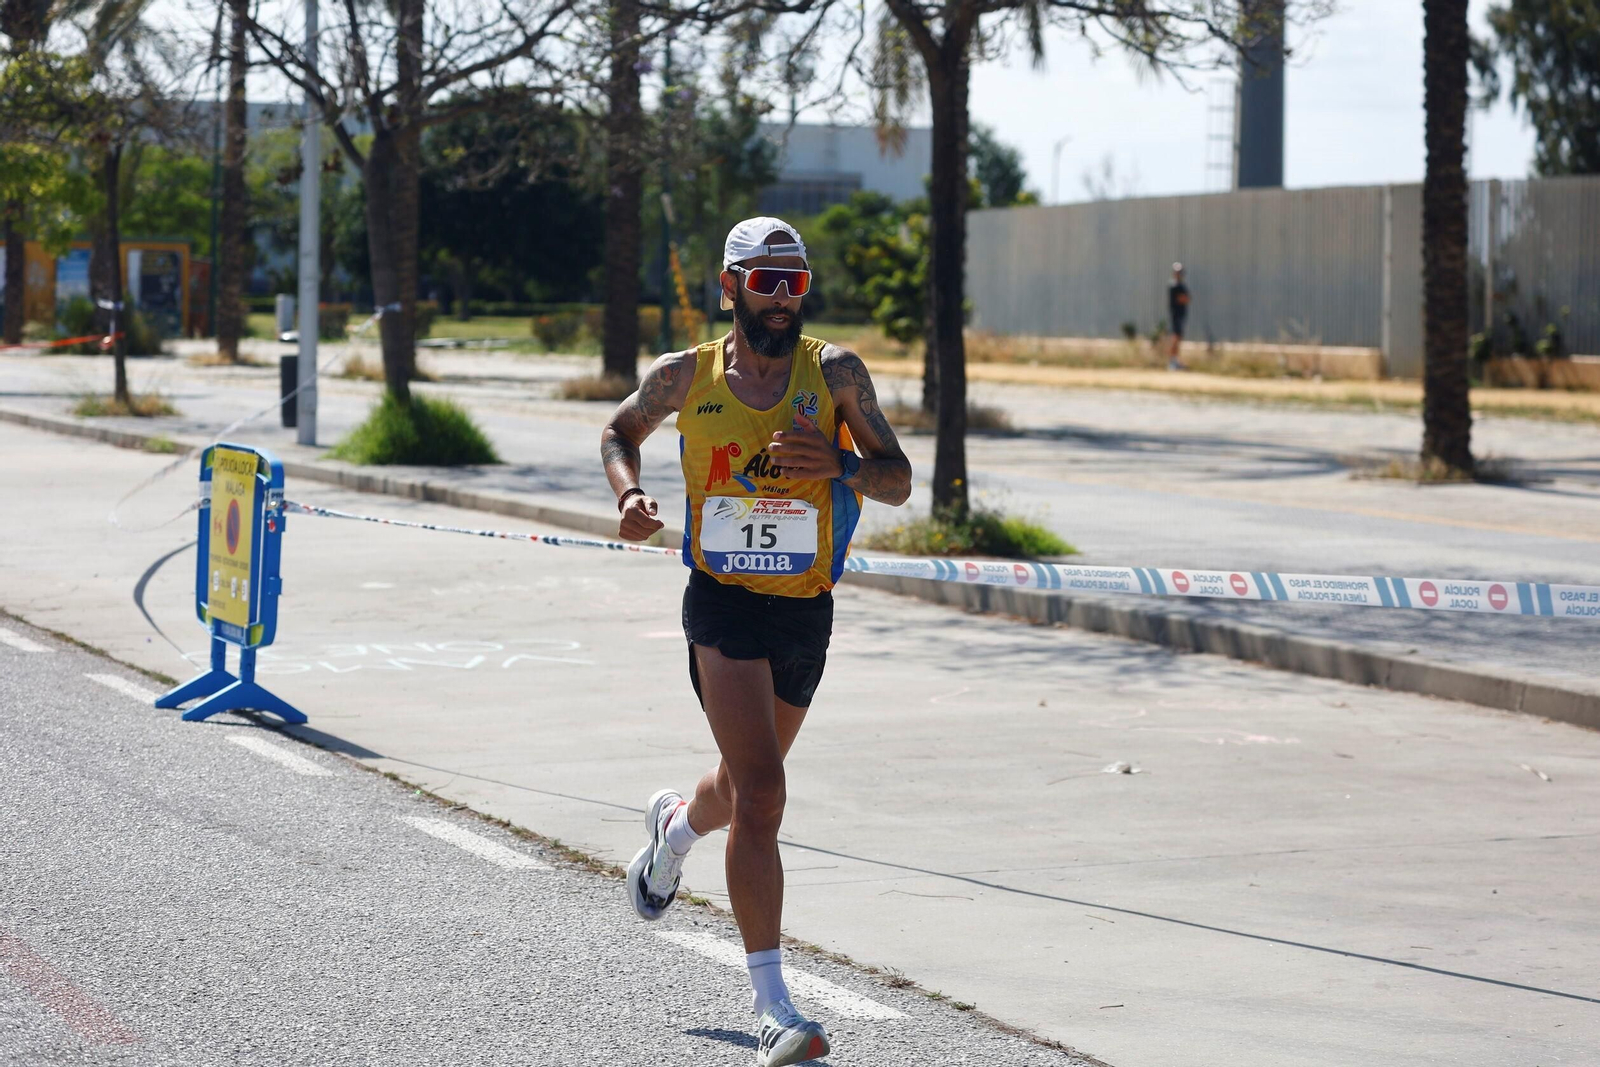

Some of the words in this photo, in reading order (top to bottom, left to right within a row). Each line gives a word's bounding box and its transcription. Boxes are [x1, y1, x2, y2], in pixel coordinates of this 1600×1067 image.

[743, 448, 803, 479] Álo
[756, 500, 792, 508] RFEA
[741, 523, 777, 549] 15
